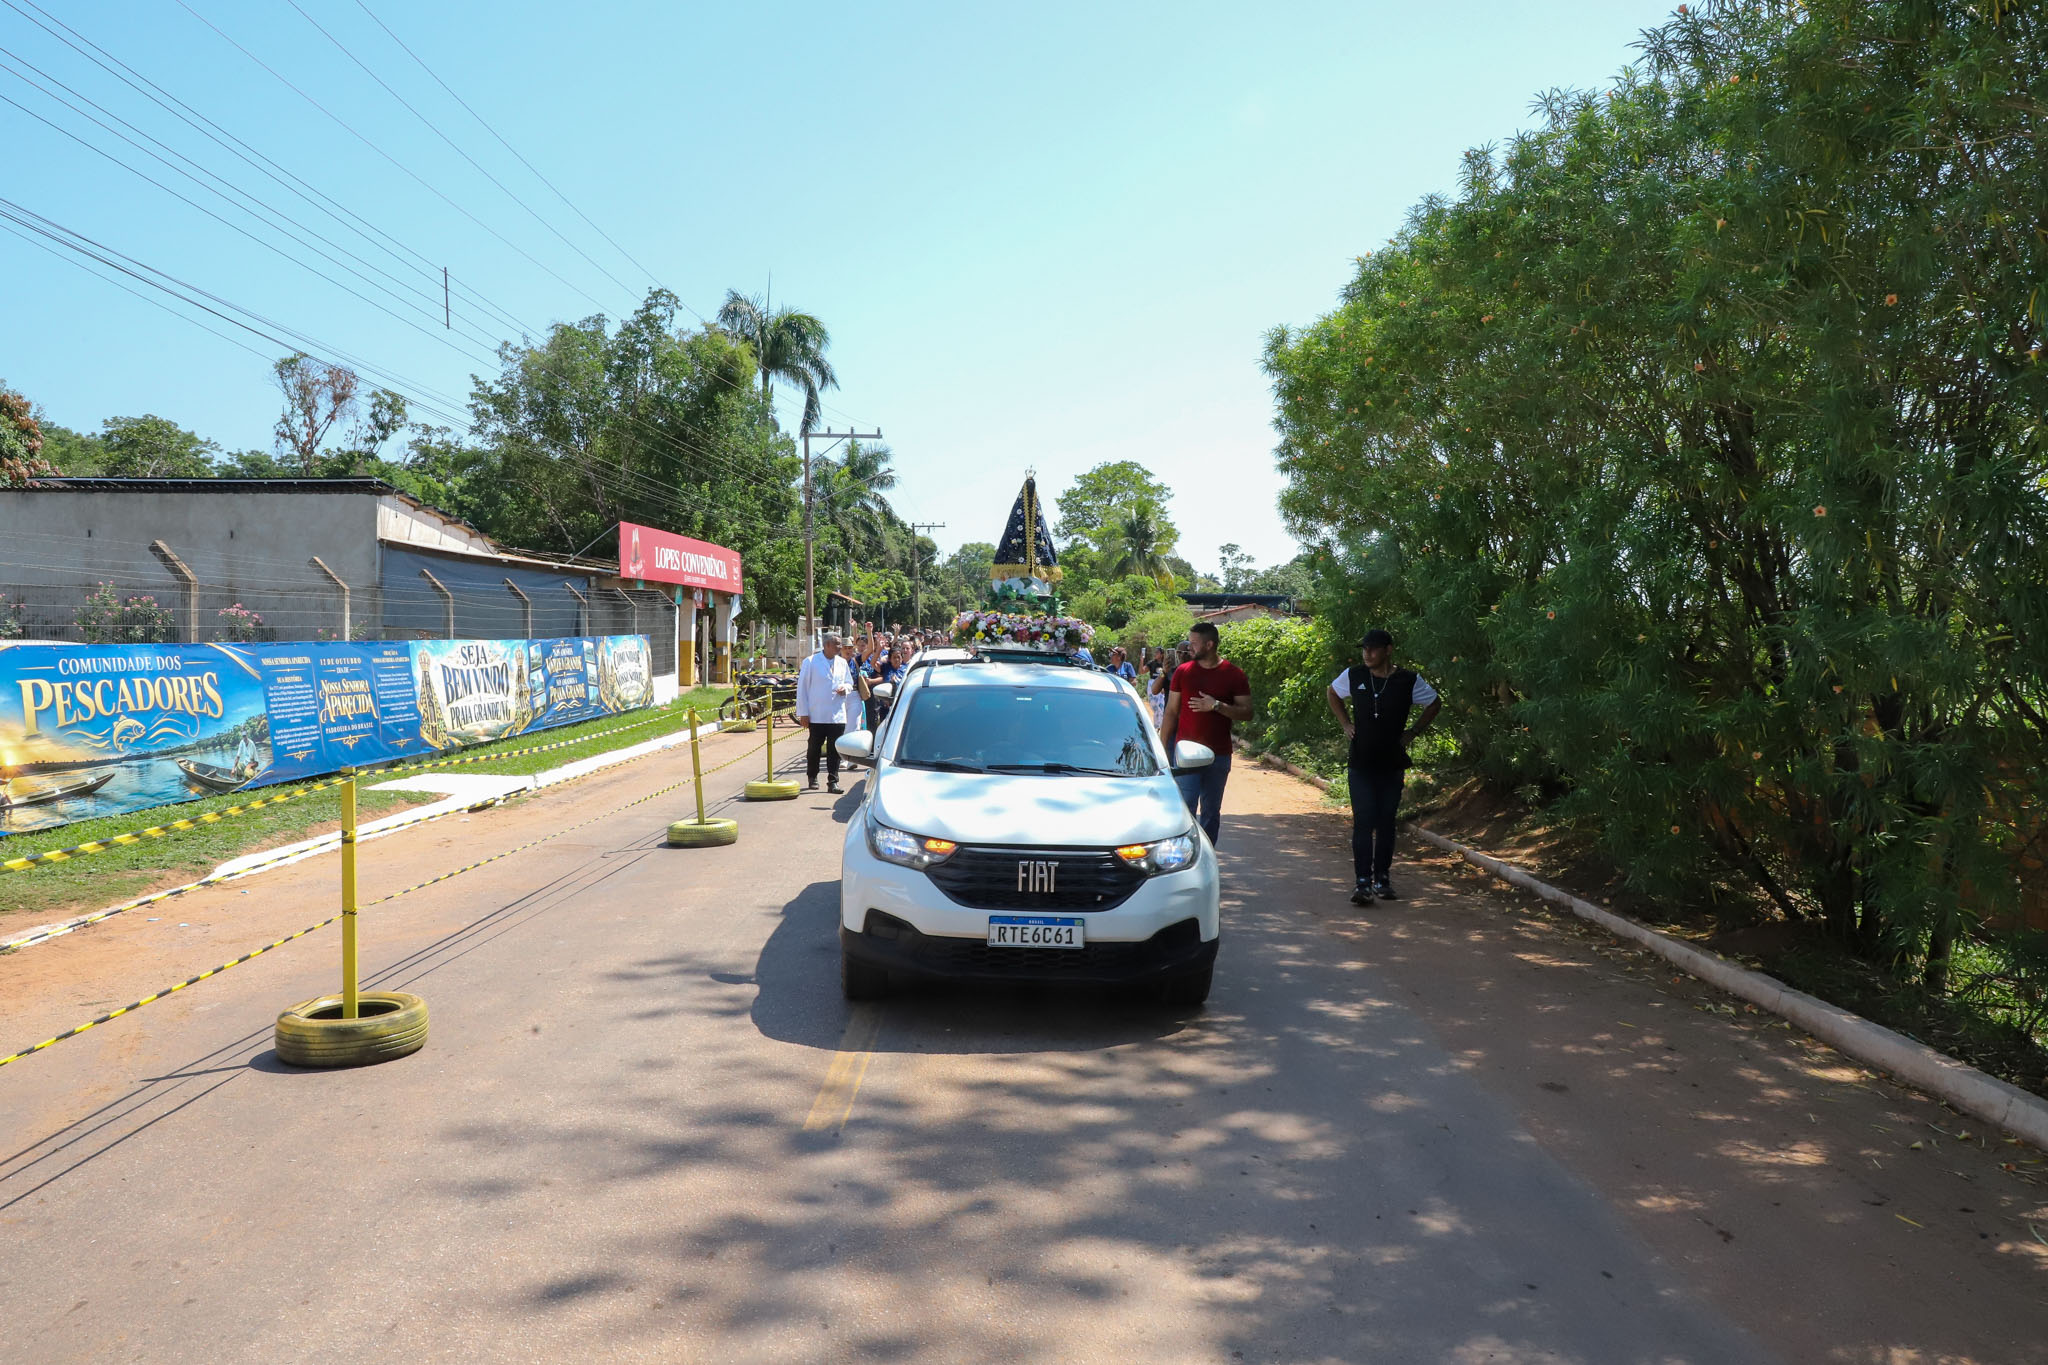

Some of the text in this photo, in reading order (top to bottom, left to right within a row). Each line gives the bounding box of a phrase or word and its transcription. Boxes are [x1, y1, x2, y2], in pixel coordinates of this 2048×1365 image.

[655, 546, 680, 571] LOPES
[681, 552, 728, 580] CONVENIÊNCIA
[58, 655, 181, 675] COMUNIDADE DOS
[336, 657, 362, 665] OUTUBRO
[461, 645, 488, 667] SEJA
[319, 679, 342, 699] NOSSA
[341, 678, 370, 693] SENHORA
[440, 662, 510, 706] BEM VINDO
[16, 671, 224, 738] PESCADORES
[320, 693, 379, 723] APARECIDA
[450, 704, 473, 731] PRAIA
[474, 701, 499, 723] GRANDE
[1018, 861, 1059, 893] FIAT
[998, 926, 1074, 945] RTE6C61
